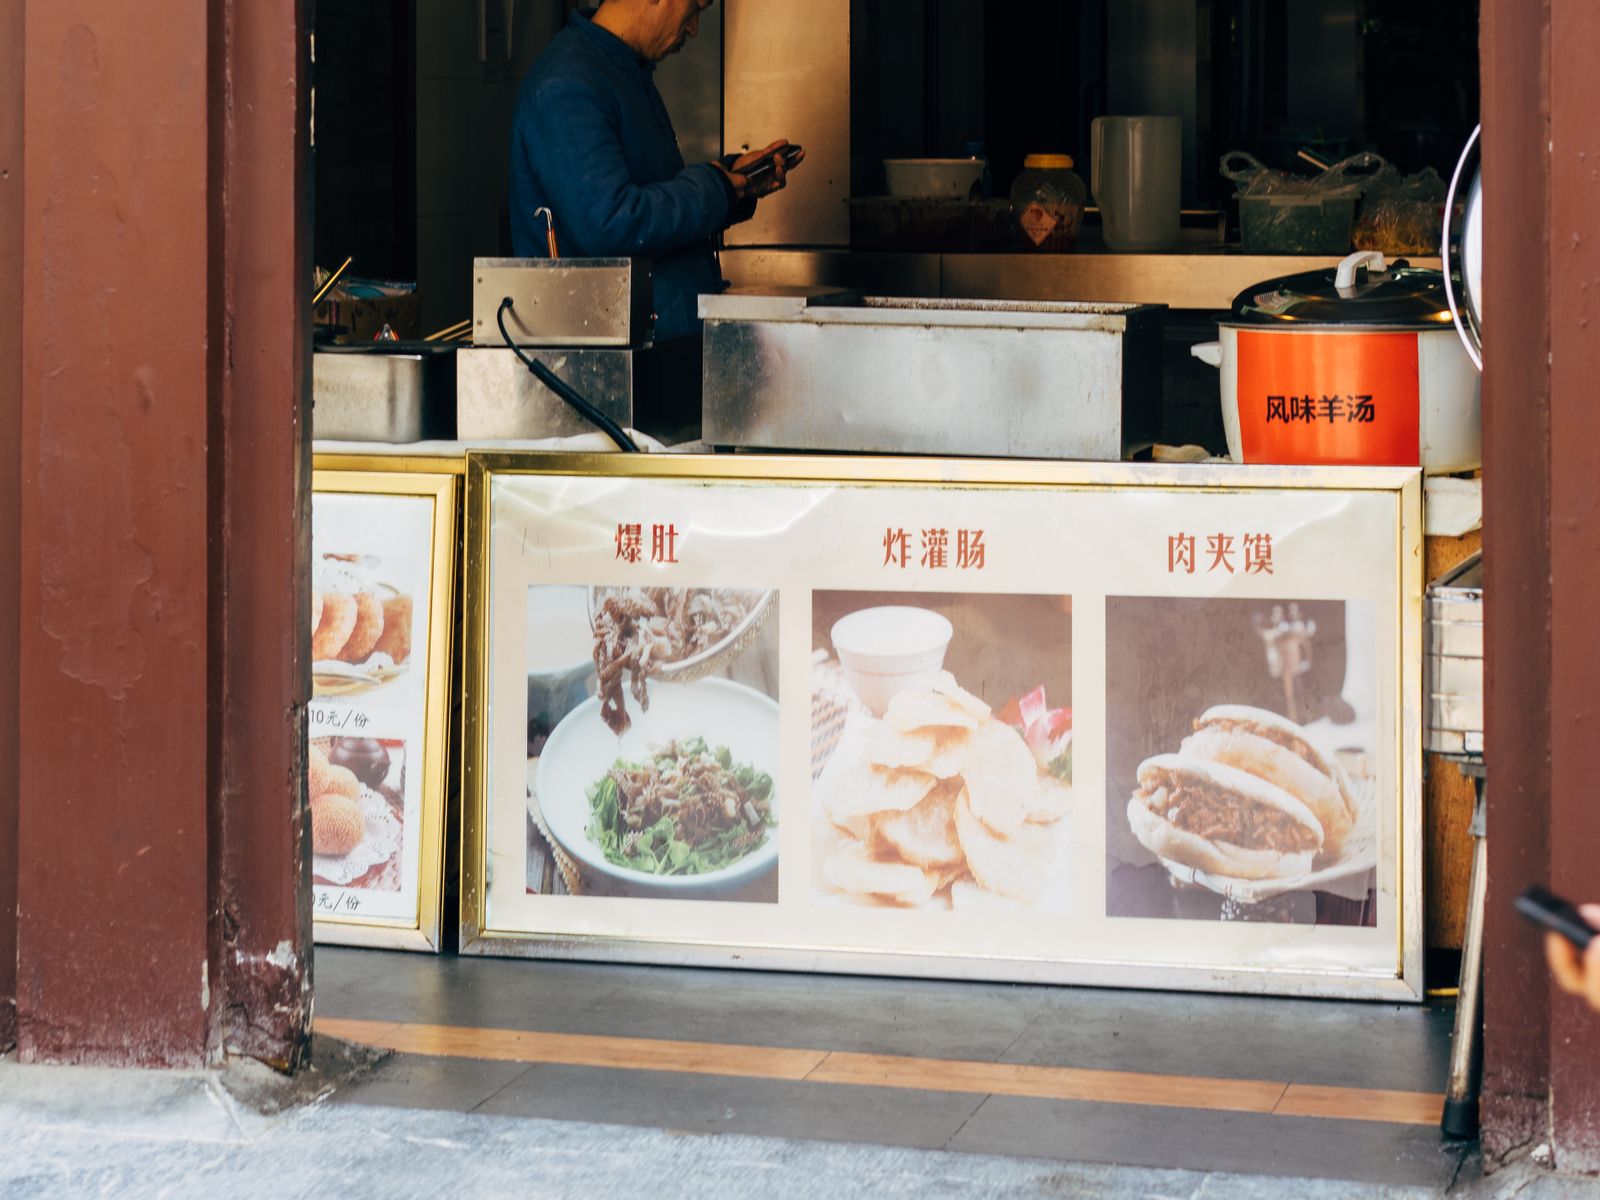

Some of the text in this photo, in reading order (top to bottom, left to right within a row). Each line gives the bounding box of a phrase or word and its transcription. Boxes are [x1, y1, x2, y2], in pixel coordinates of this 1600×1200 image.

[1266, 394, 1375, 424] 风味羊汤
[614, 523, 679, 563] 爆肚
[883, 527, 985, 569] 炸灌肠
[1167, 532, 1273, 575] 肉夹馍
